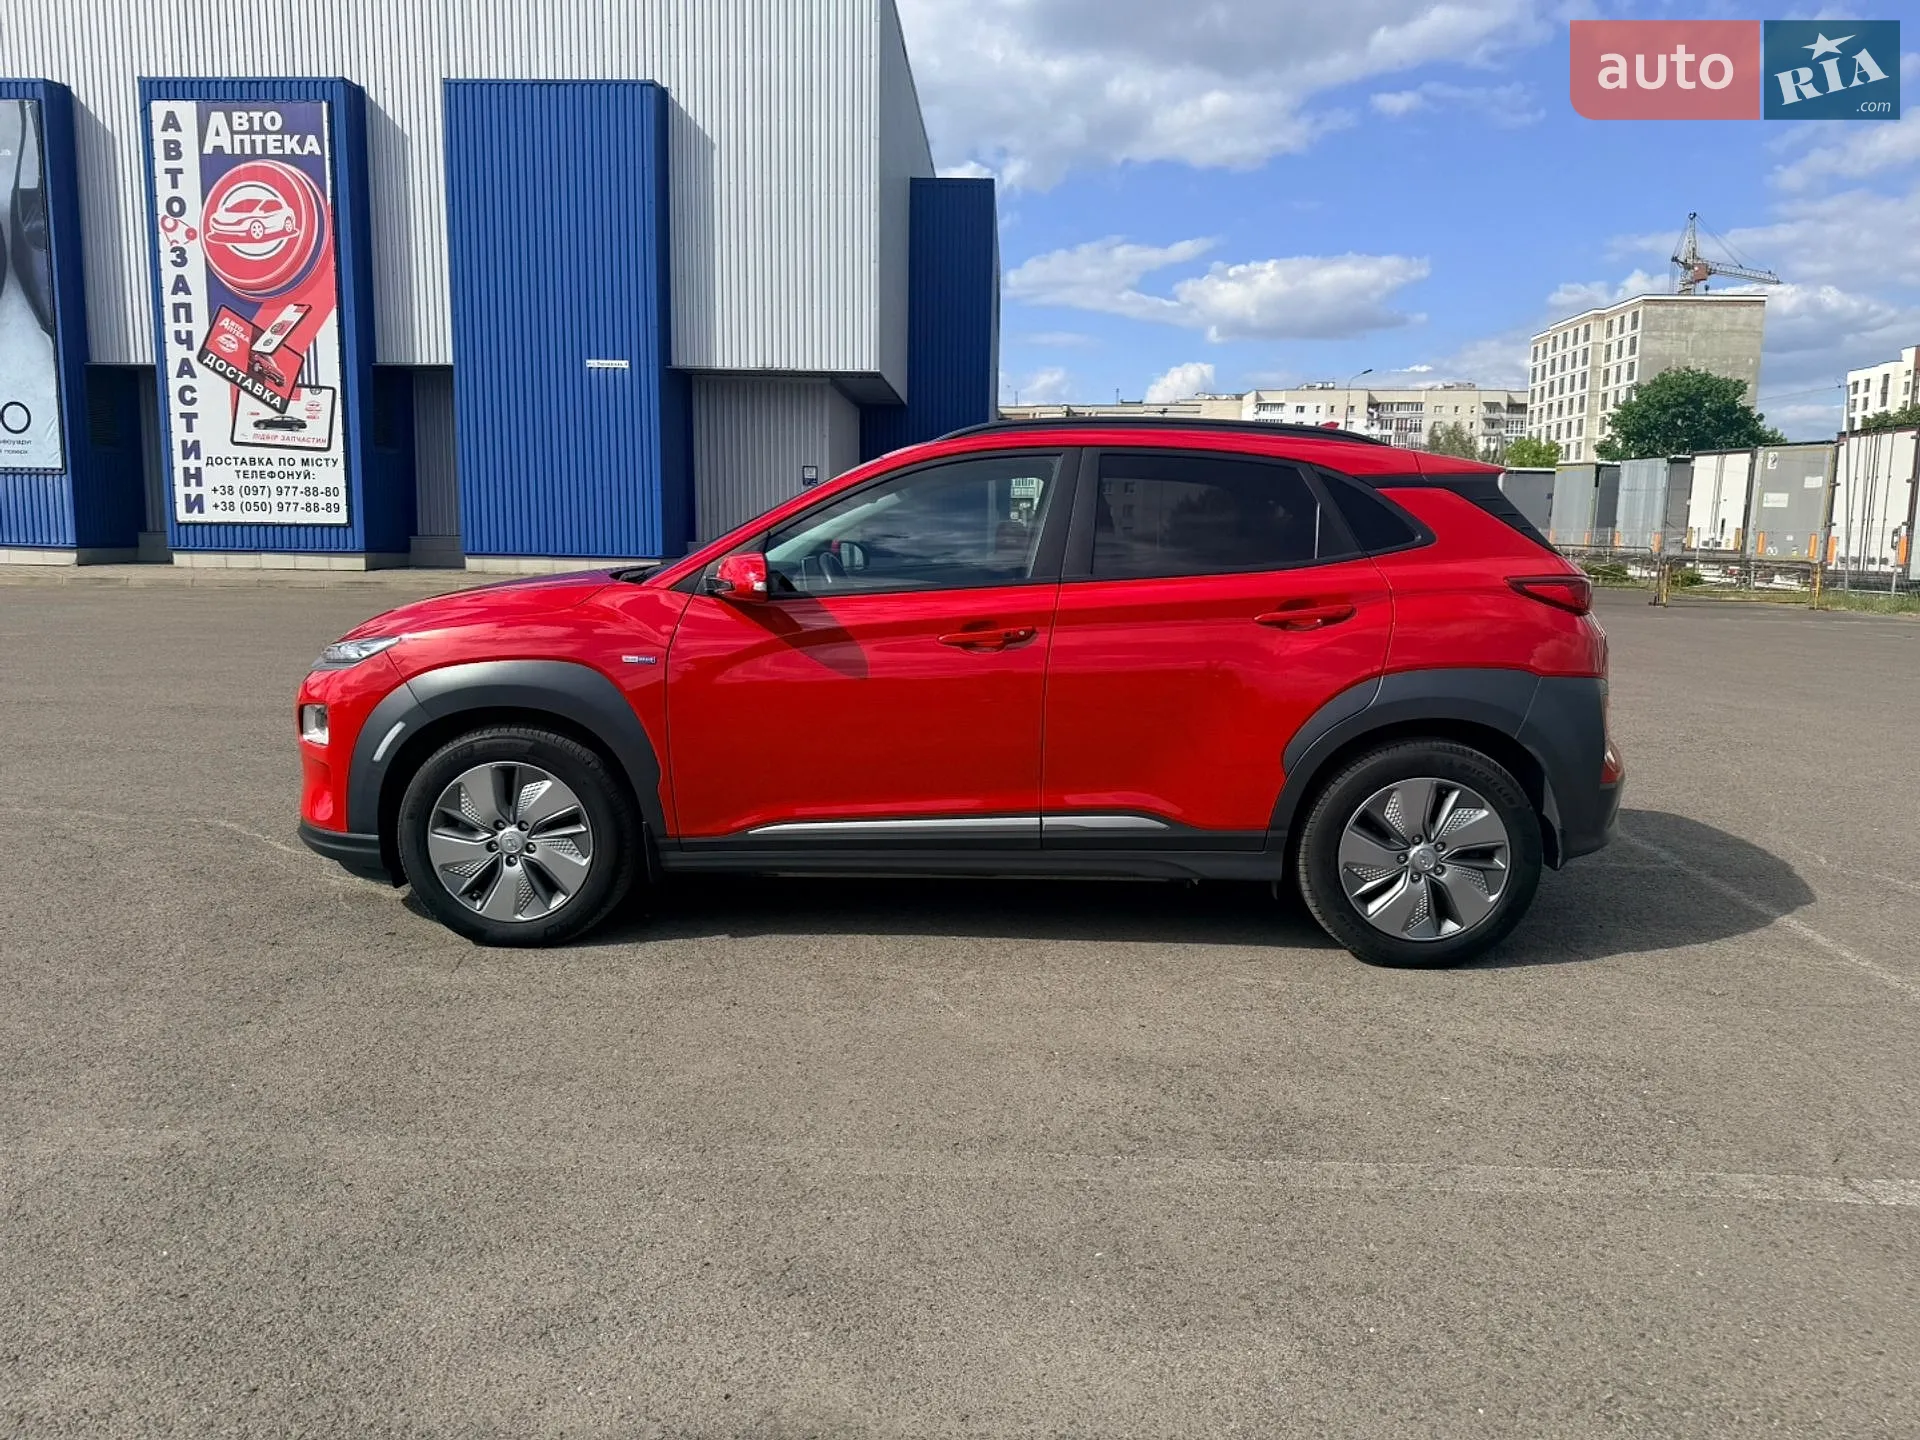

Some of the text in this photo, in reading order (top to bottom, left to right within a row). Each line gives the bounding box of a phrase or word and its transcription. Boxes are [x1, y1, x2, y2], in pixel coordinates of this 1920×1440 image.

[203, 353, 282, 408] ДОСТАВКА
[206, 456, 339, 467] ДОСТАВКА ПО МІСТУ
[235, 469, 316, 480] ТЕЛЕФОНУЙ:
[211, 485, 340, 498] +38 (097) 977-88-80
[212, 501, 236, 512] +38
[240, 501, 272, 514] (050)
